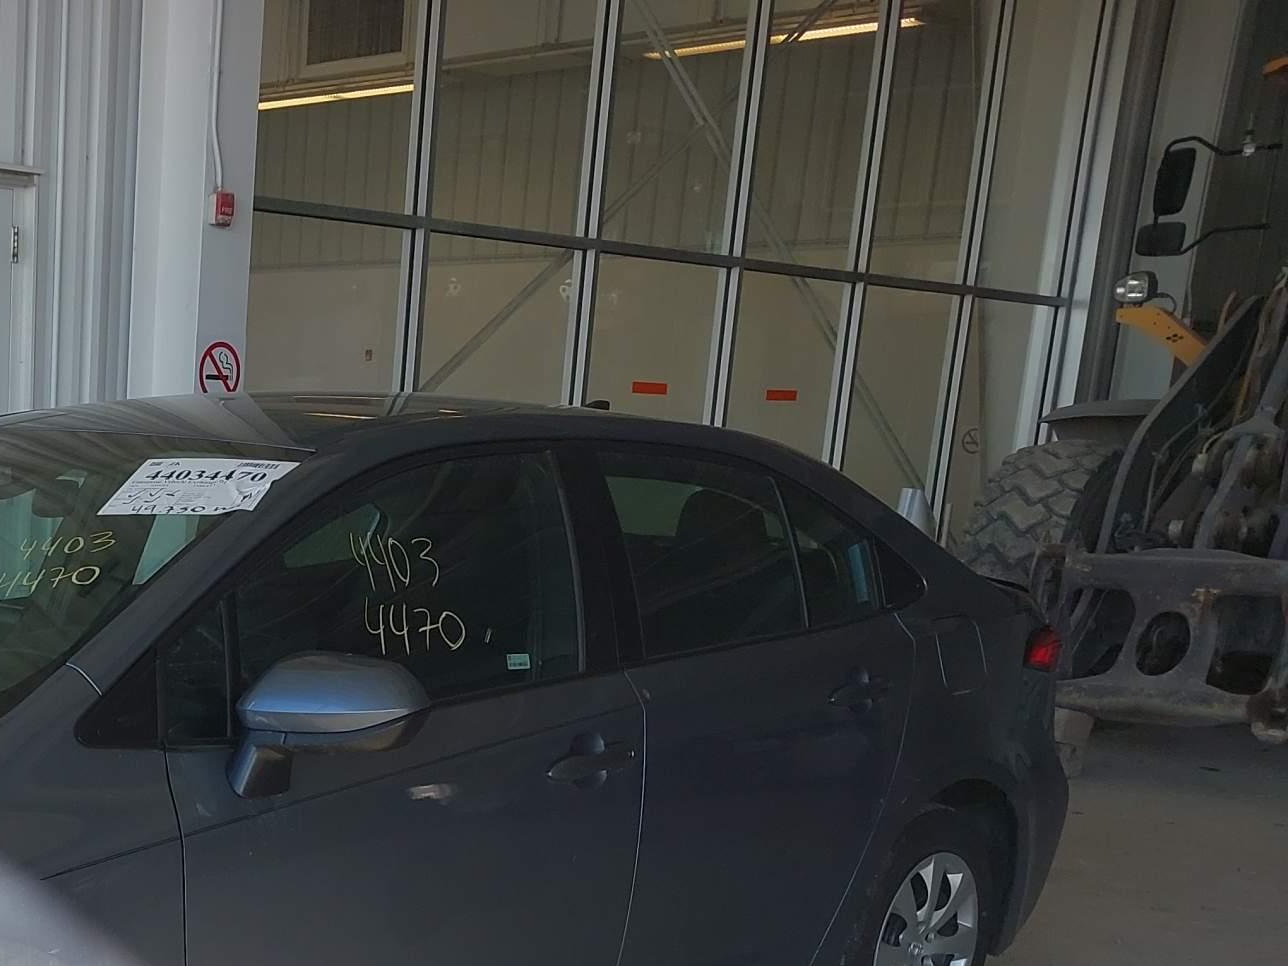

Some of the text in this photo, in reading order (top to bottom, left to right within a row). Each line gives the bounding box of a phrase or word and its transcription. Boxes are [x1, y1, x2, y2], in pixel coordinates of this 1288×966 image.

[144, 468, 268, 482] 44034470
[20, 531, 116, 560] 4403
[349, 531, 440, 592] 4403
[365, 597, 466, 656] 4470
